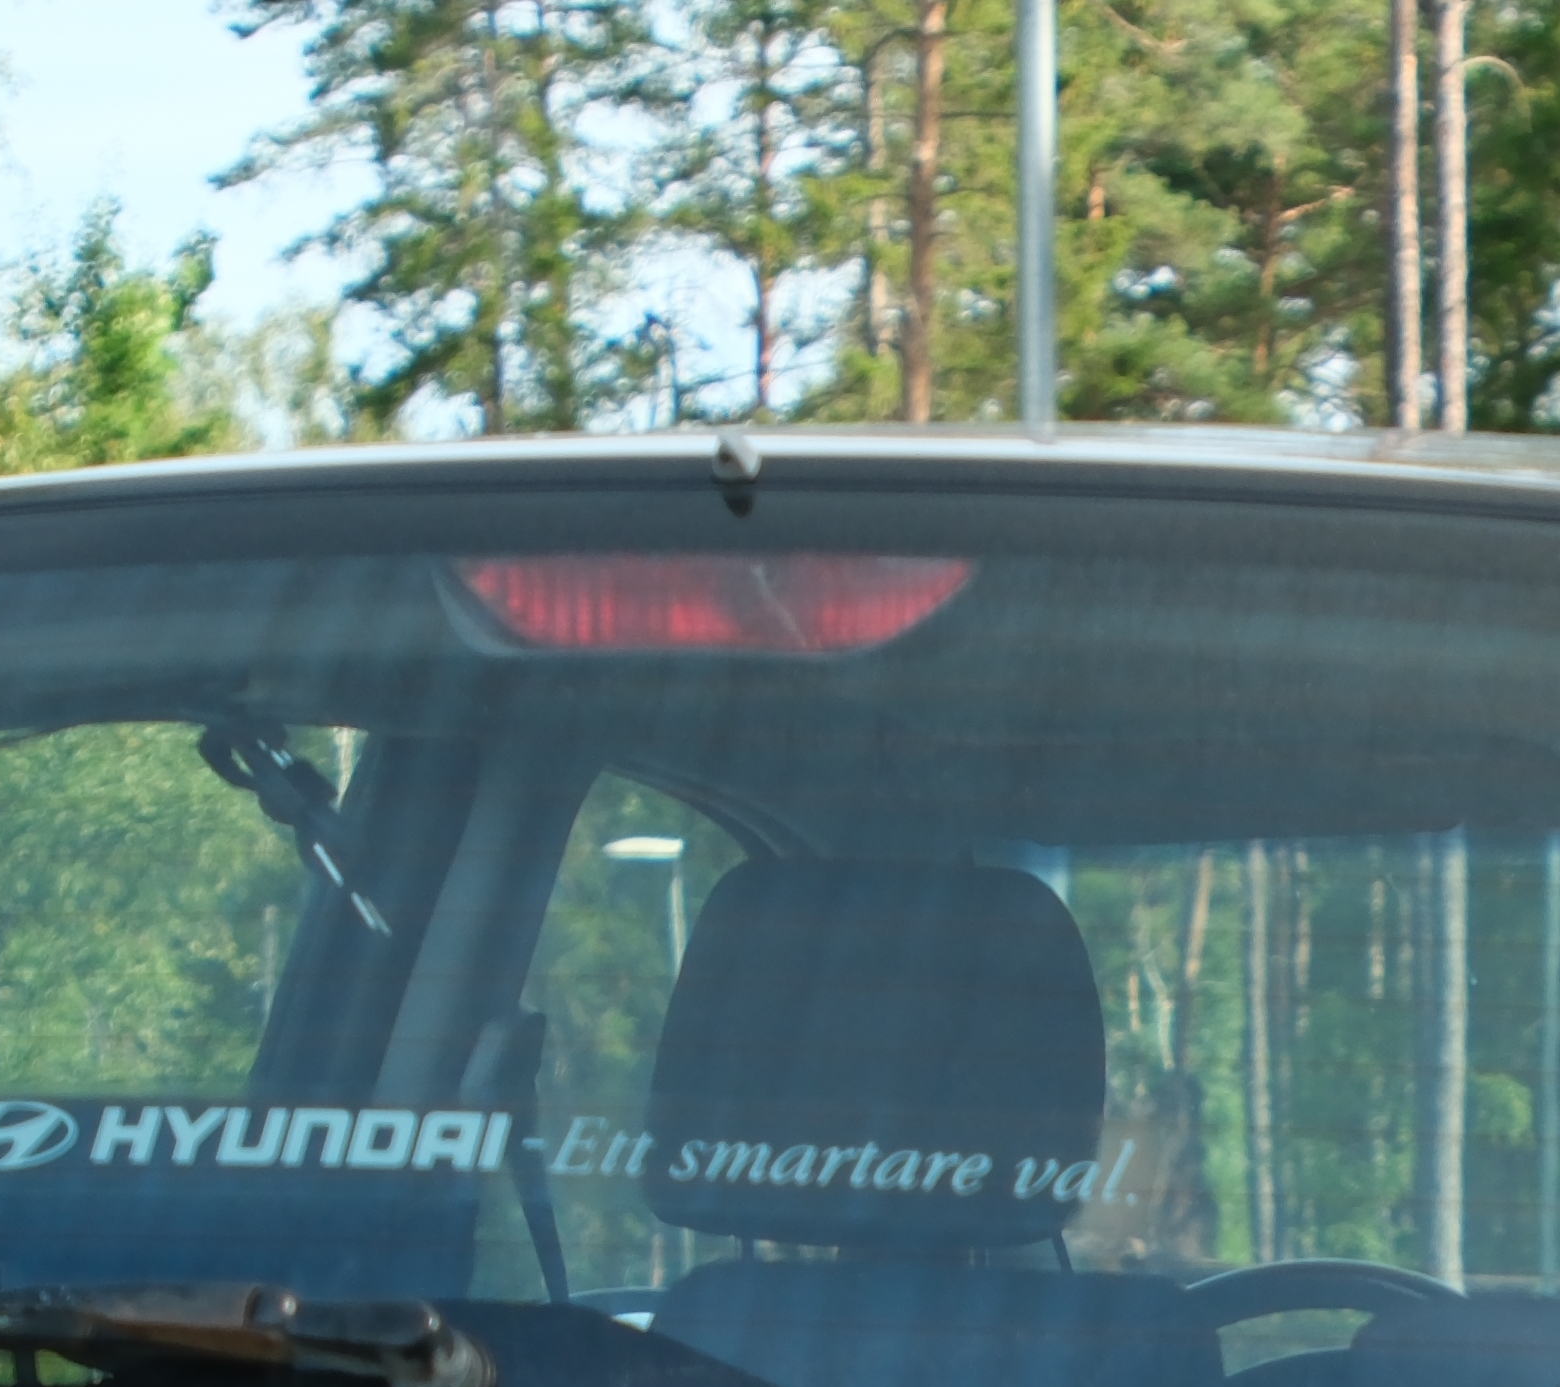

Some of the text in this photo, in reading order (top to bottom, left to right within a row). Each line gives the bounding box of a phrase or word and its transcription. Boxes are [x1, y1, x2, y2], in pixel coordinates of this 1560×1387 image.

[89, 1106, 510, 1171] HYUNDAI
[669, 1138, 993, 1196] smartare
[1014, 1138, 1140, 1205] val.
